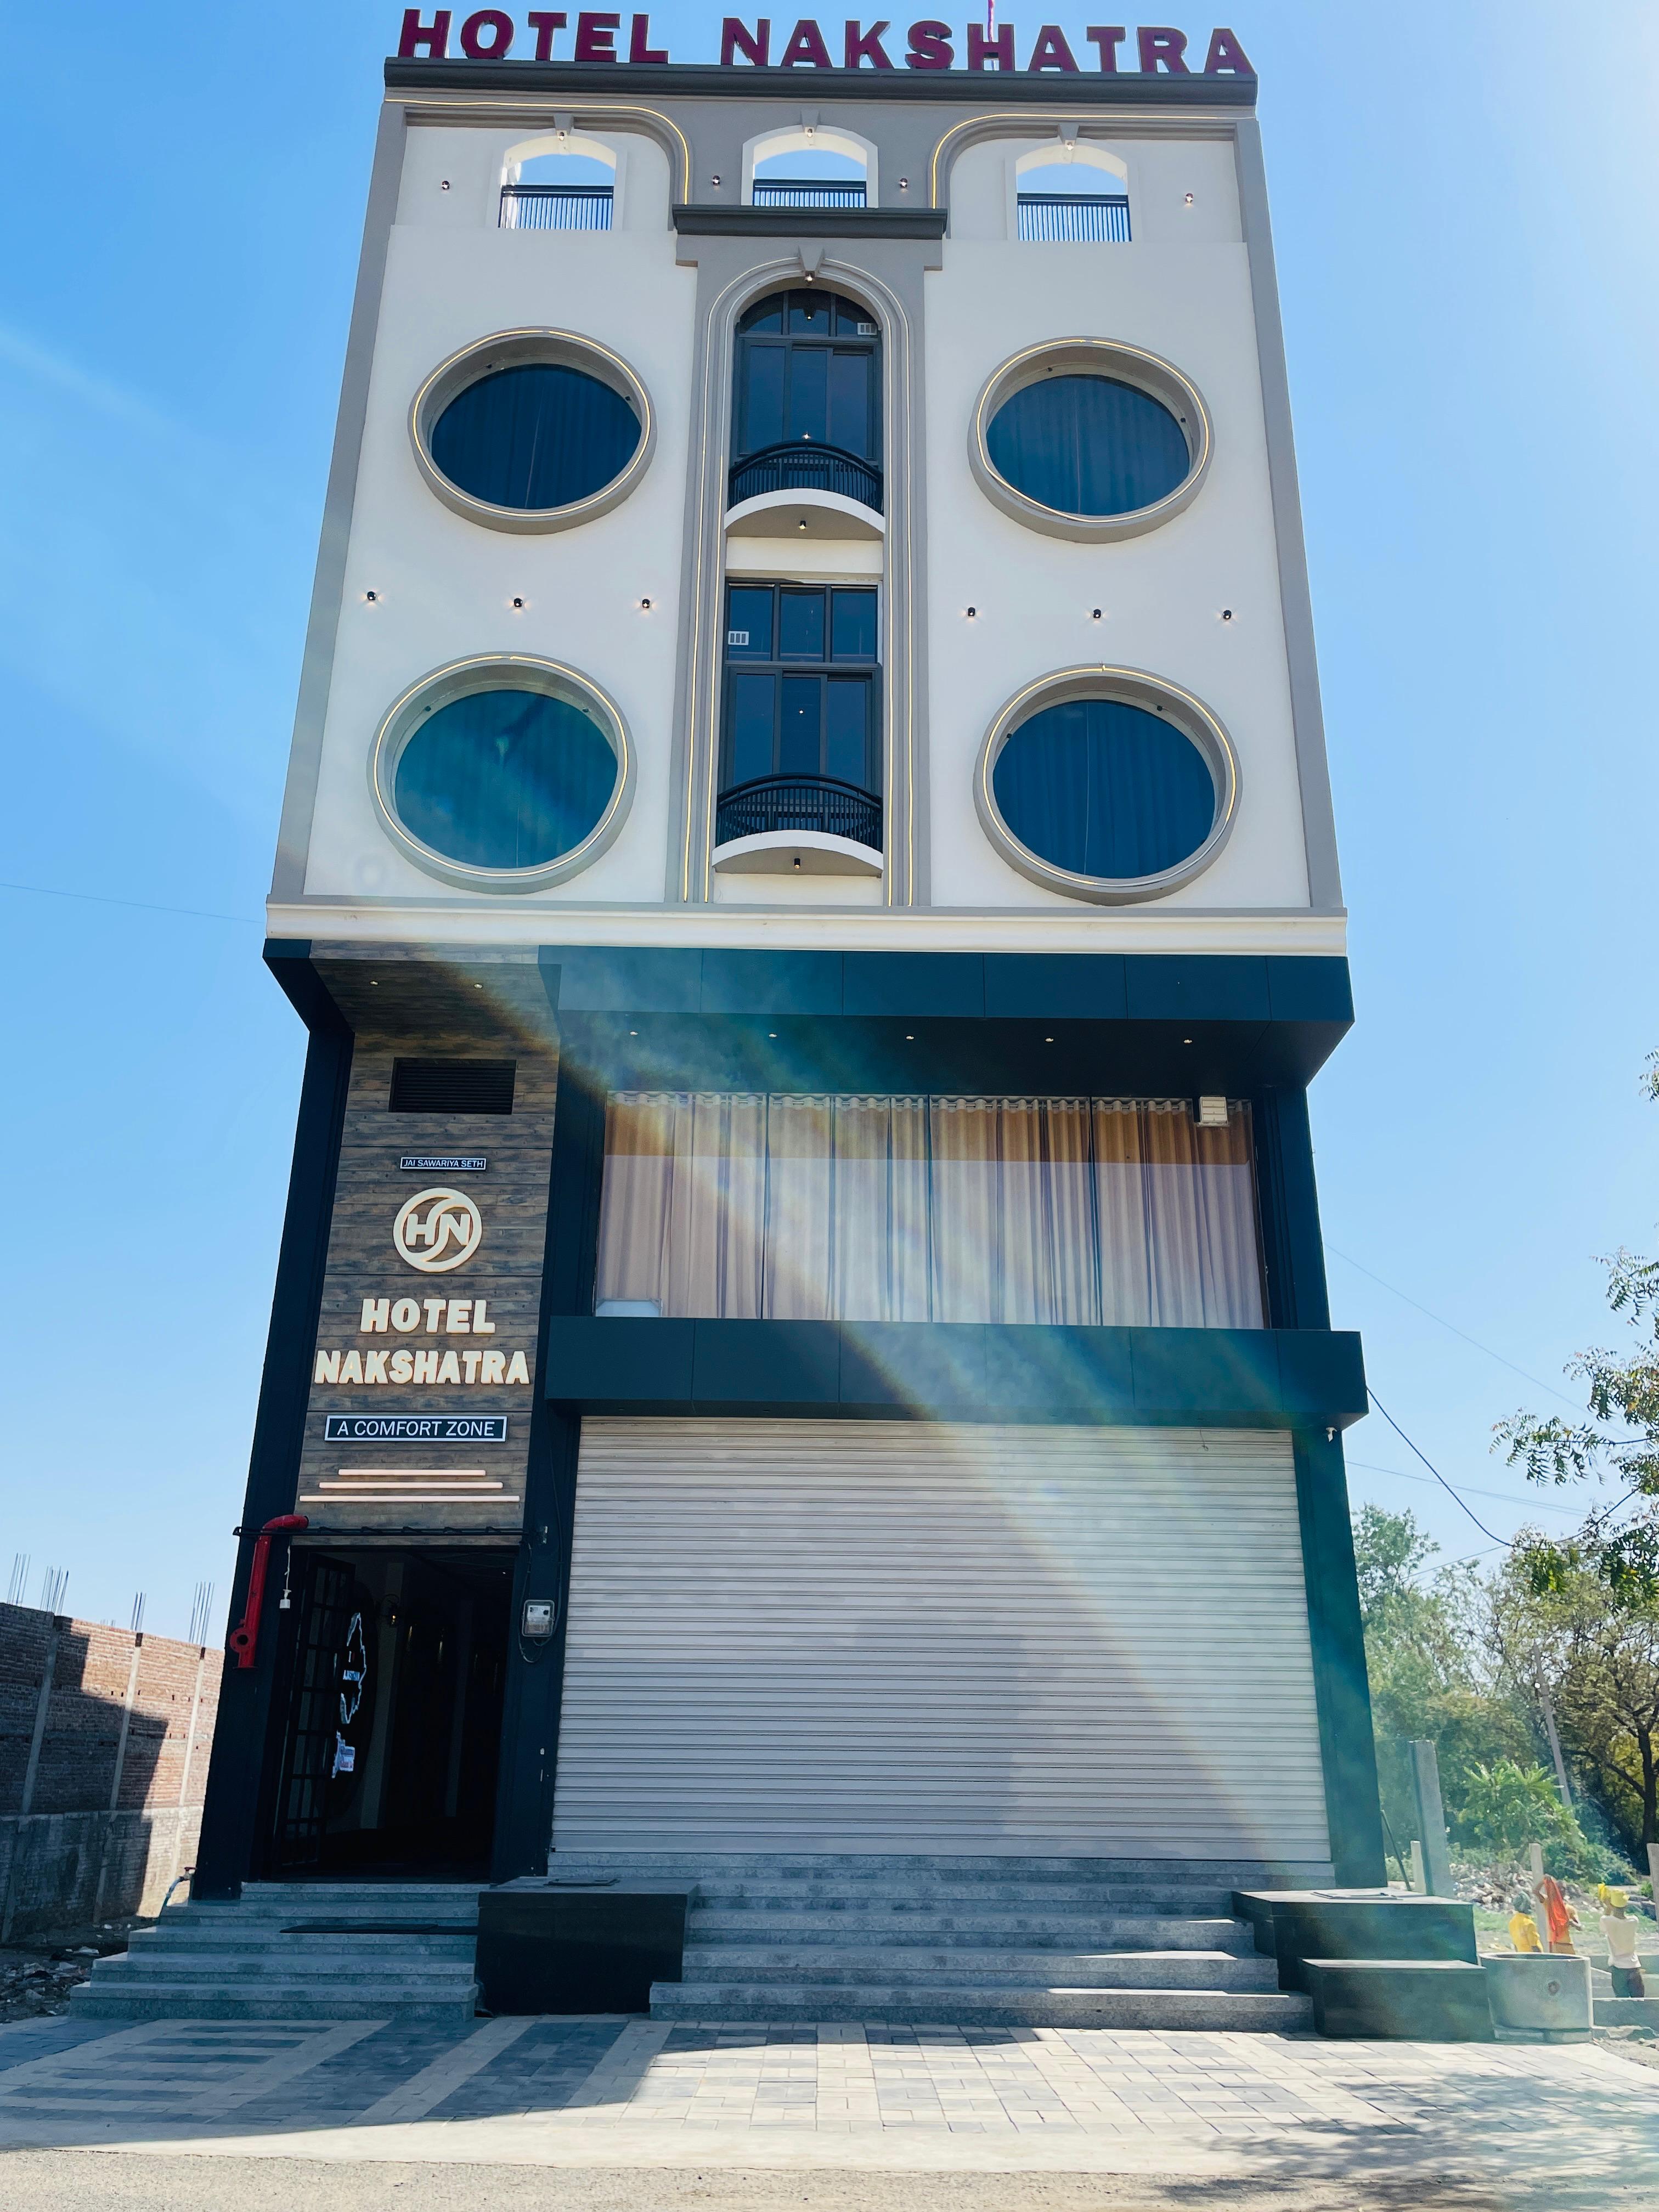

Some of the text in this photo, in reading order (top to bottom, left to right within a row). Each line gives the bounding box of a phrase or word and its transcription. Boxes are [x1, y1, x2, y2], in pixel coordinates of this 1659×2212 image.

[398, 8, 1255, 74] HOTEL NAKSHATRA
[360, 1297, 495, 1334] HOTEL
[314, 1350, 530, 1384] NAKSHATRA
[337, 1420, 495, 1436] A COMFORT ZONE
